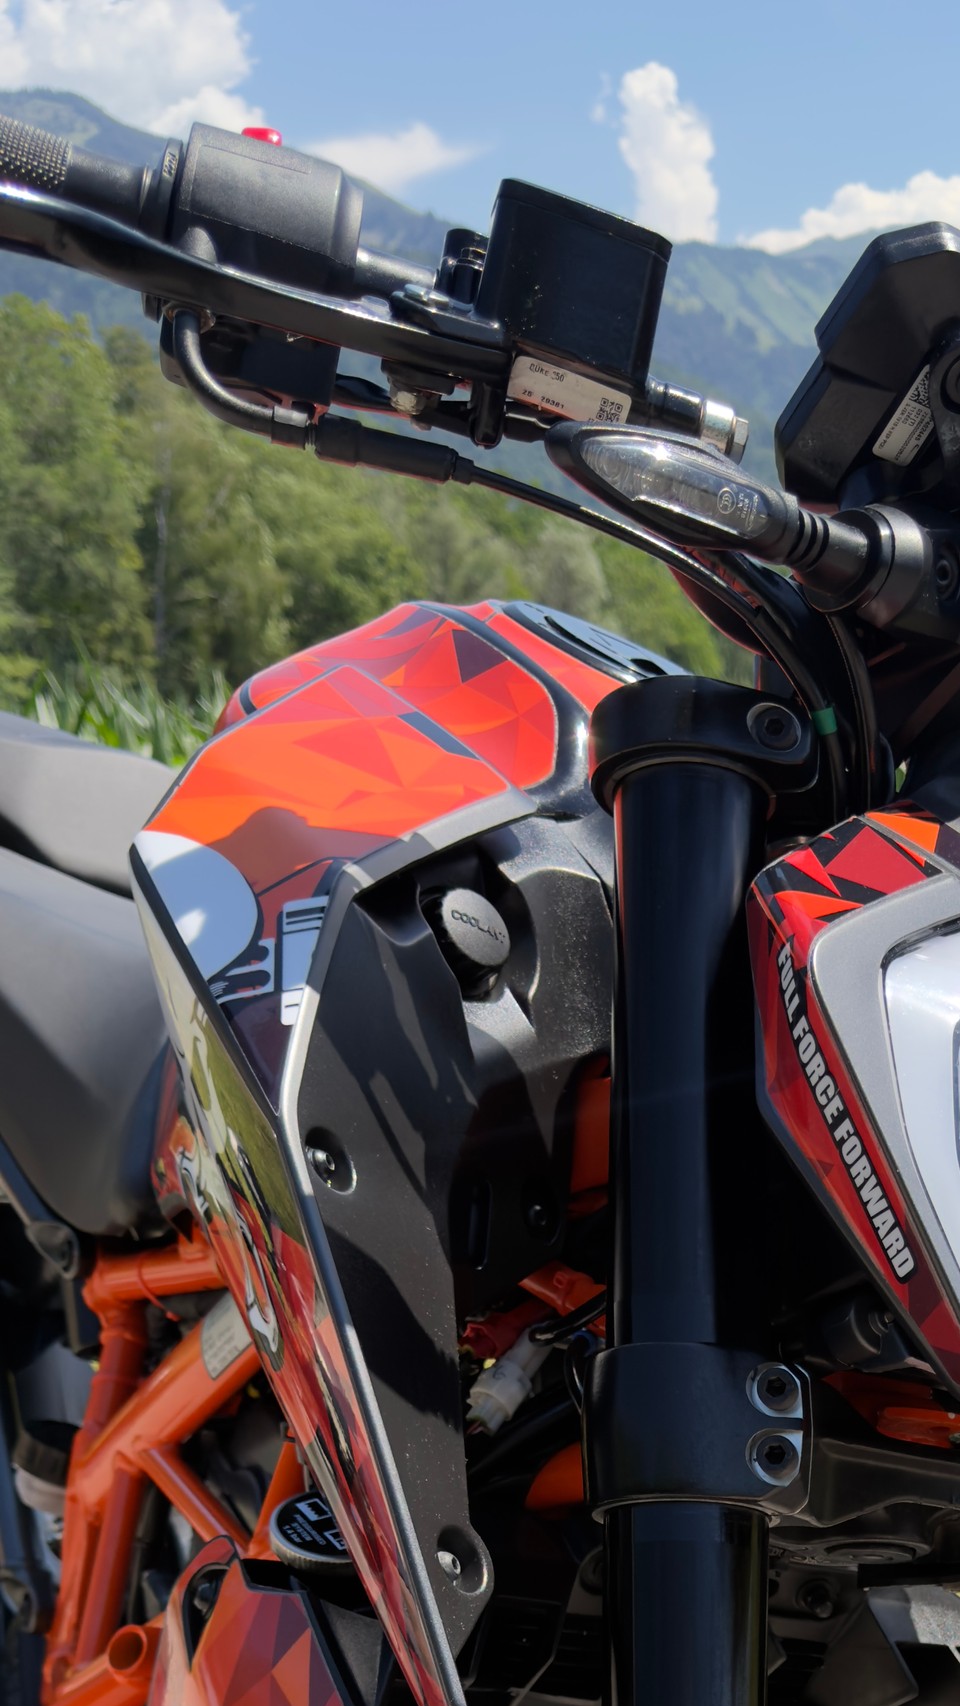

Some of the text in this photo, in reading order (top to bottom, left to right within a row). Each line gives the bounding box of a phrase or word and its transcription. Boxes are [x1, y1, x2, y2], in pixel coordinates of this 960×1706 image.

[777, 943, 916, 1279] FULL FORCE FORWARD
